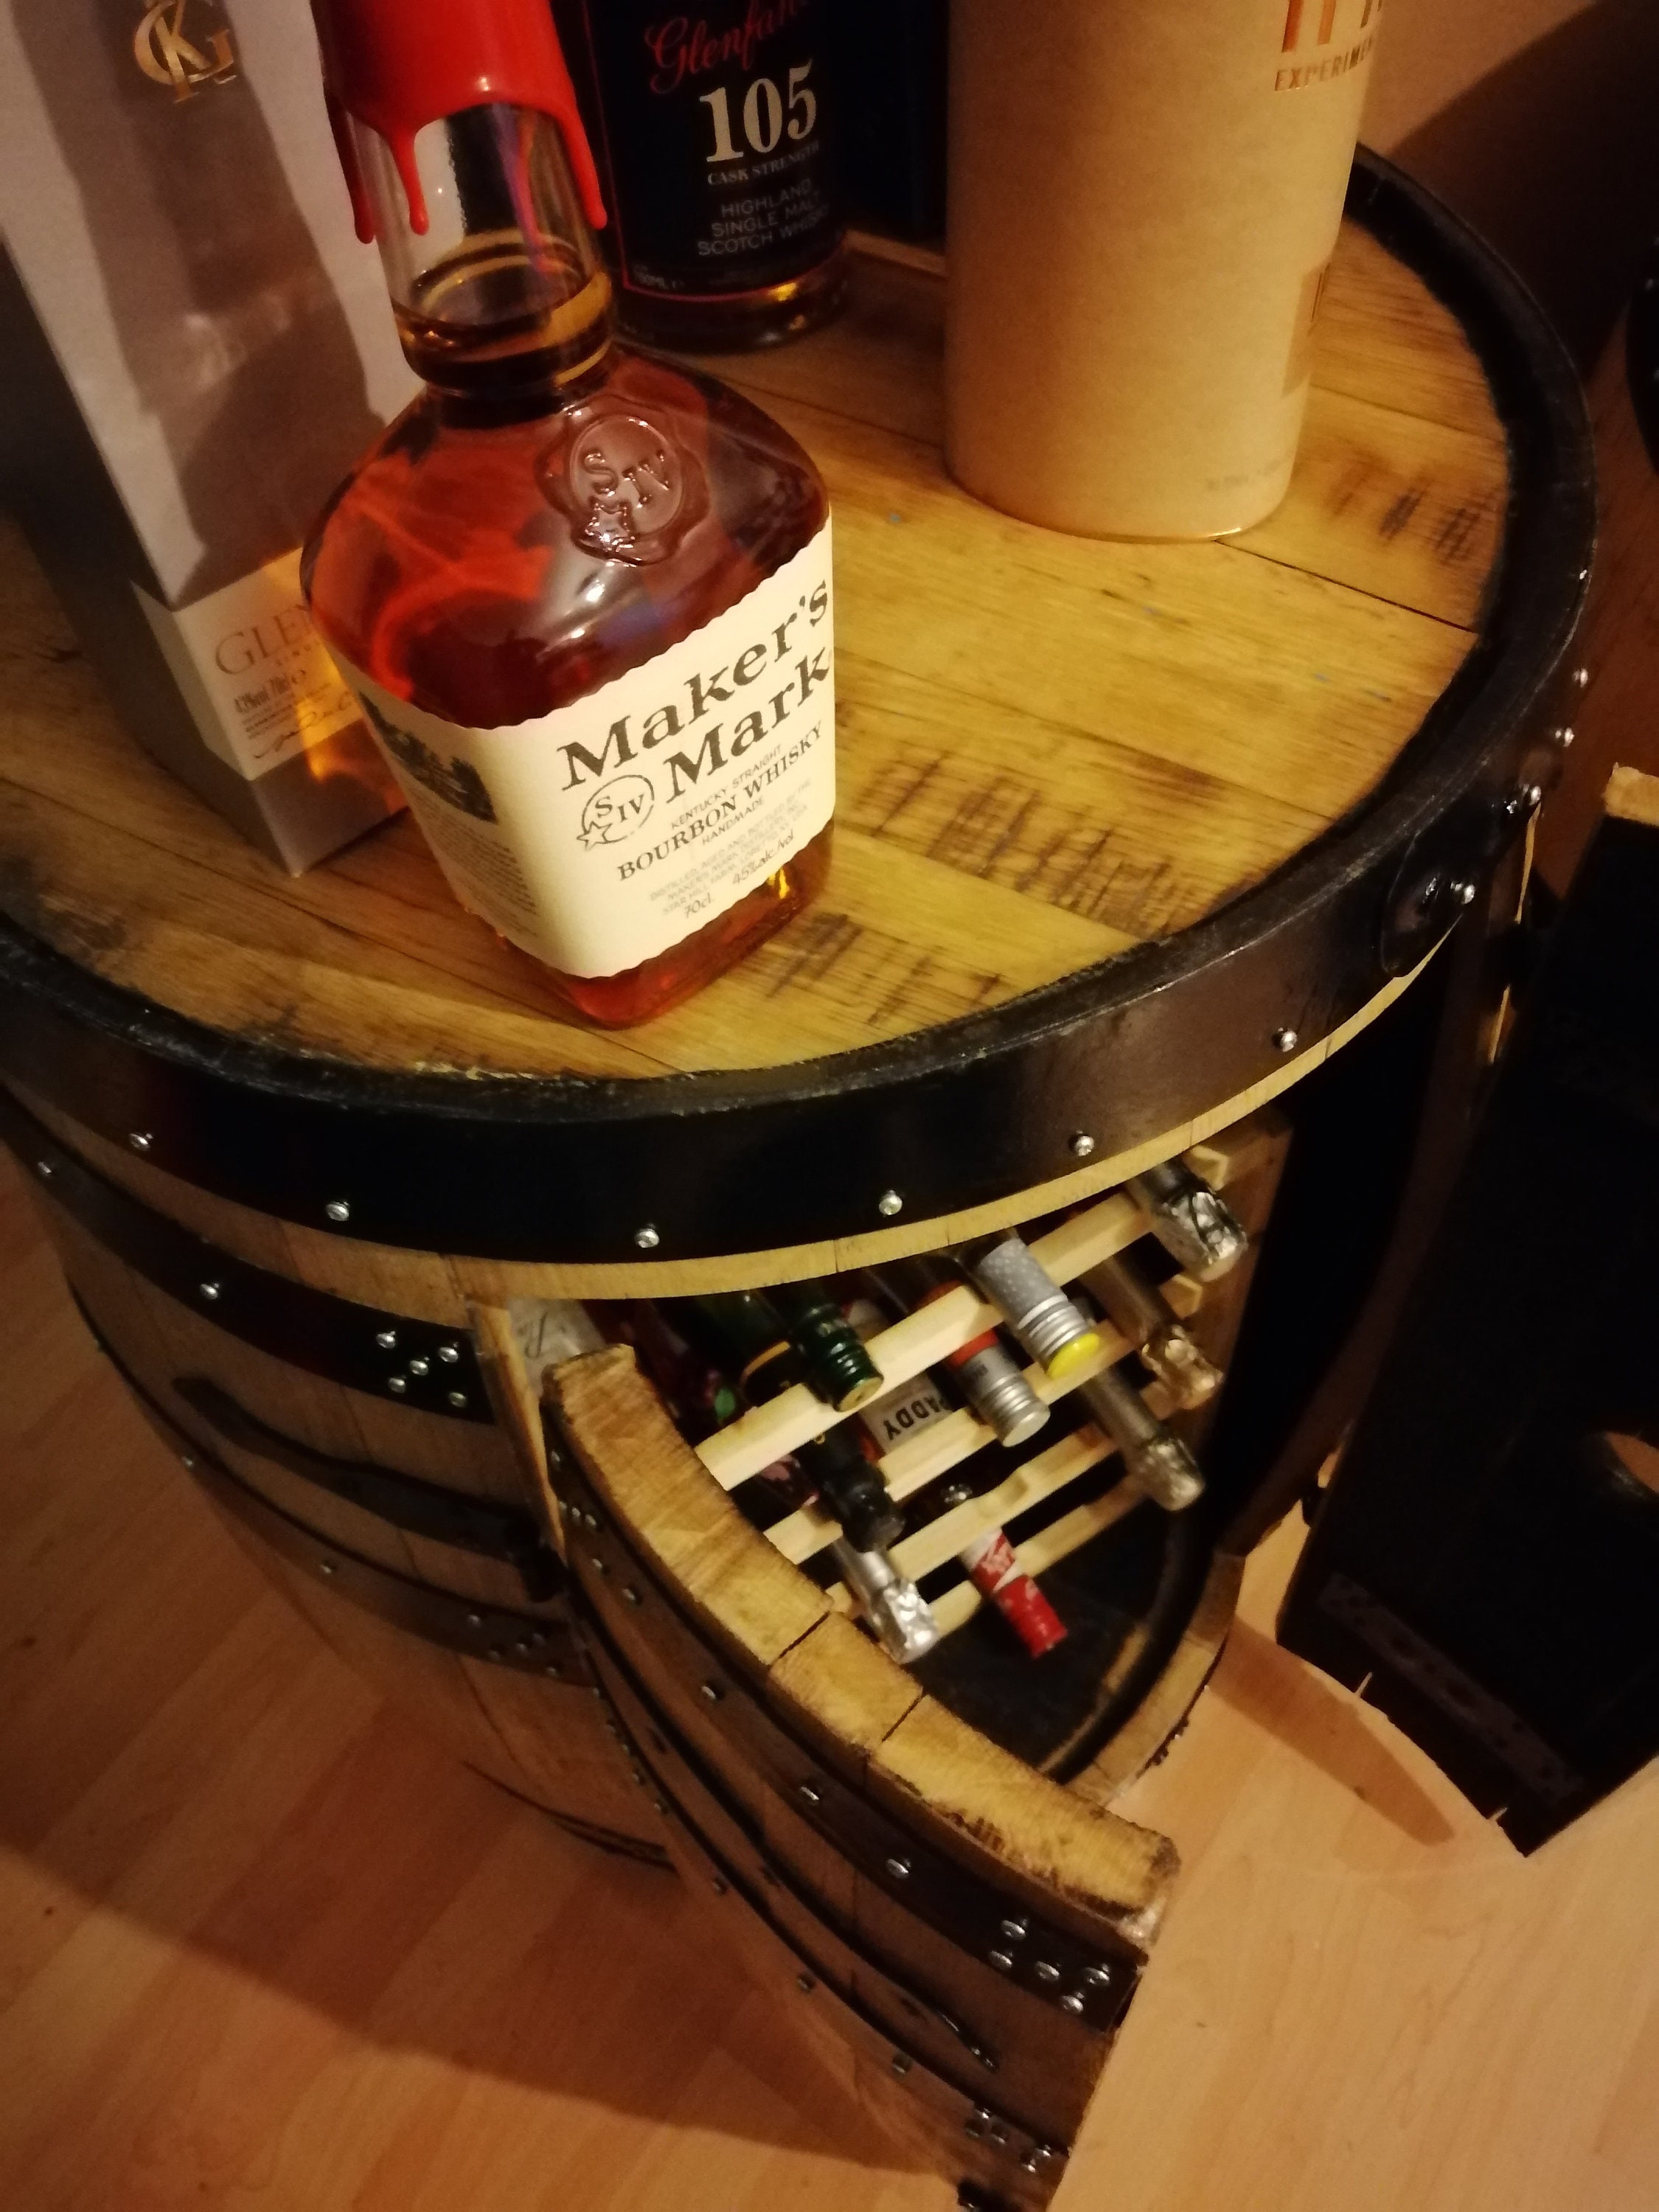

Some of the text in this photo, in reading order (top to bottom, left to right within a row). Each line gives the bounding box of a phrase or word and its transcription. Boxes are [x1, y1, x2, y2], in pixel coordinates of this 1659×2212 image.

[699, 56, 817, 162] 105
[708, 164, 749, 185] CASK
[720, 178, 812, 218] HIGHLAND
[698, 233, 773, 257] SCOTCH
[711, 211, 779, 238] SINGLE
[557, 580, 828, 790] Maker's
[663, 647, 832, 804] Mark
[617, 795, 737, 881] BOURBON
[743, 720, 824, 800] WHISKY
[671, 744, 783, 829] KENTUCKY STRAIGHT
[702, 796, 766, 846] HANDMADE
[728, 833, 747, 851] AND
